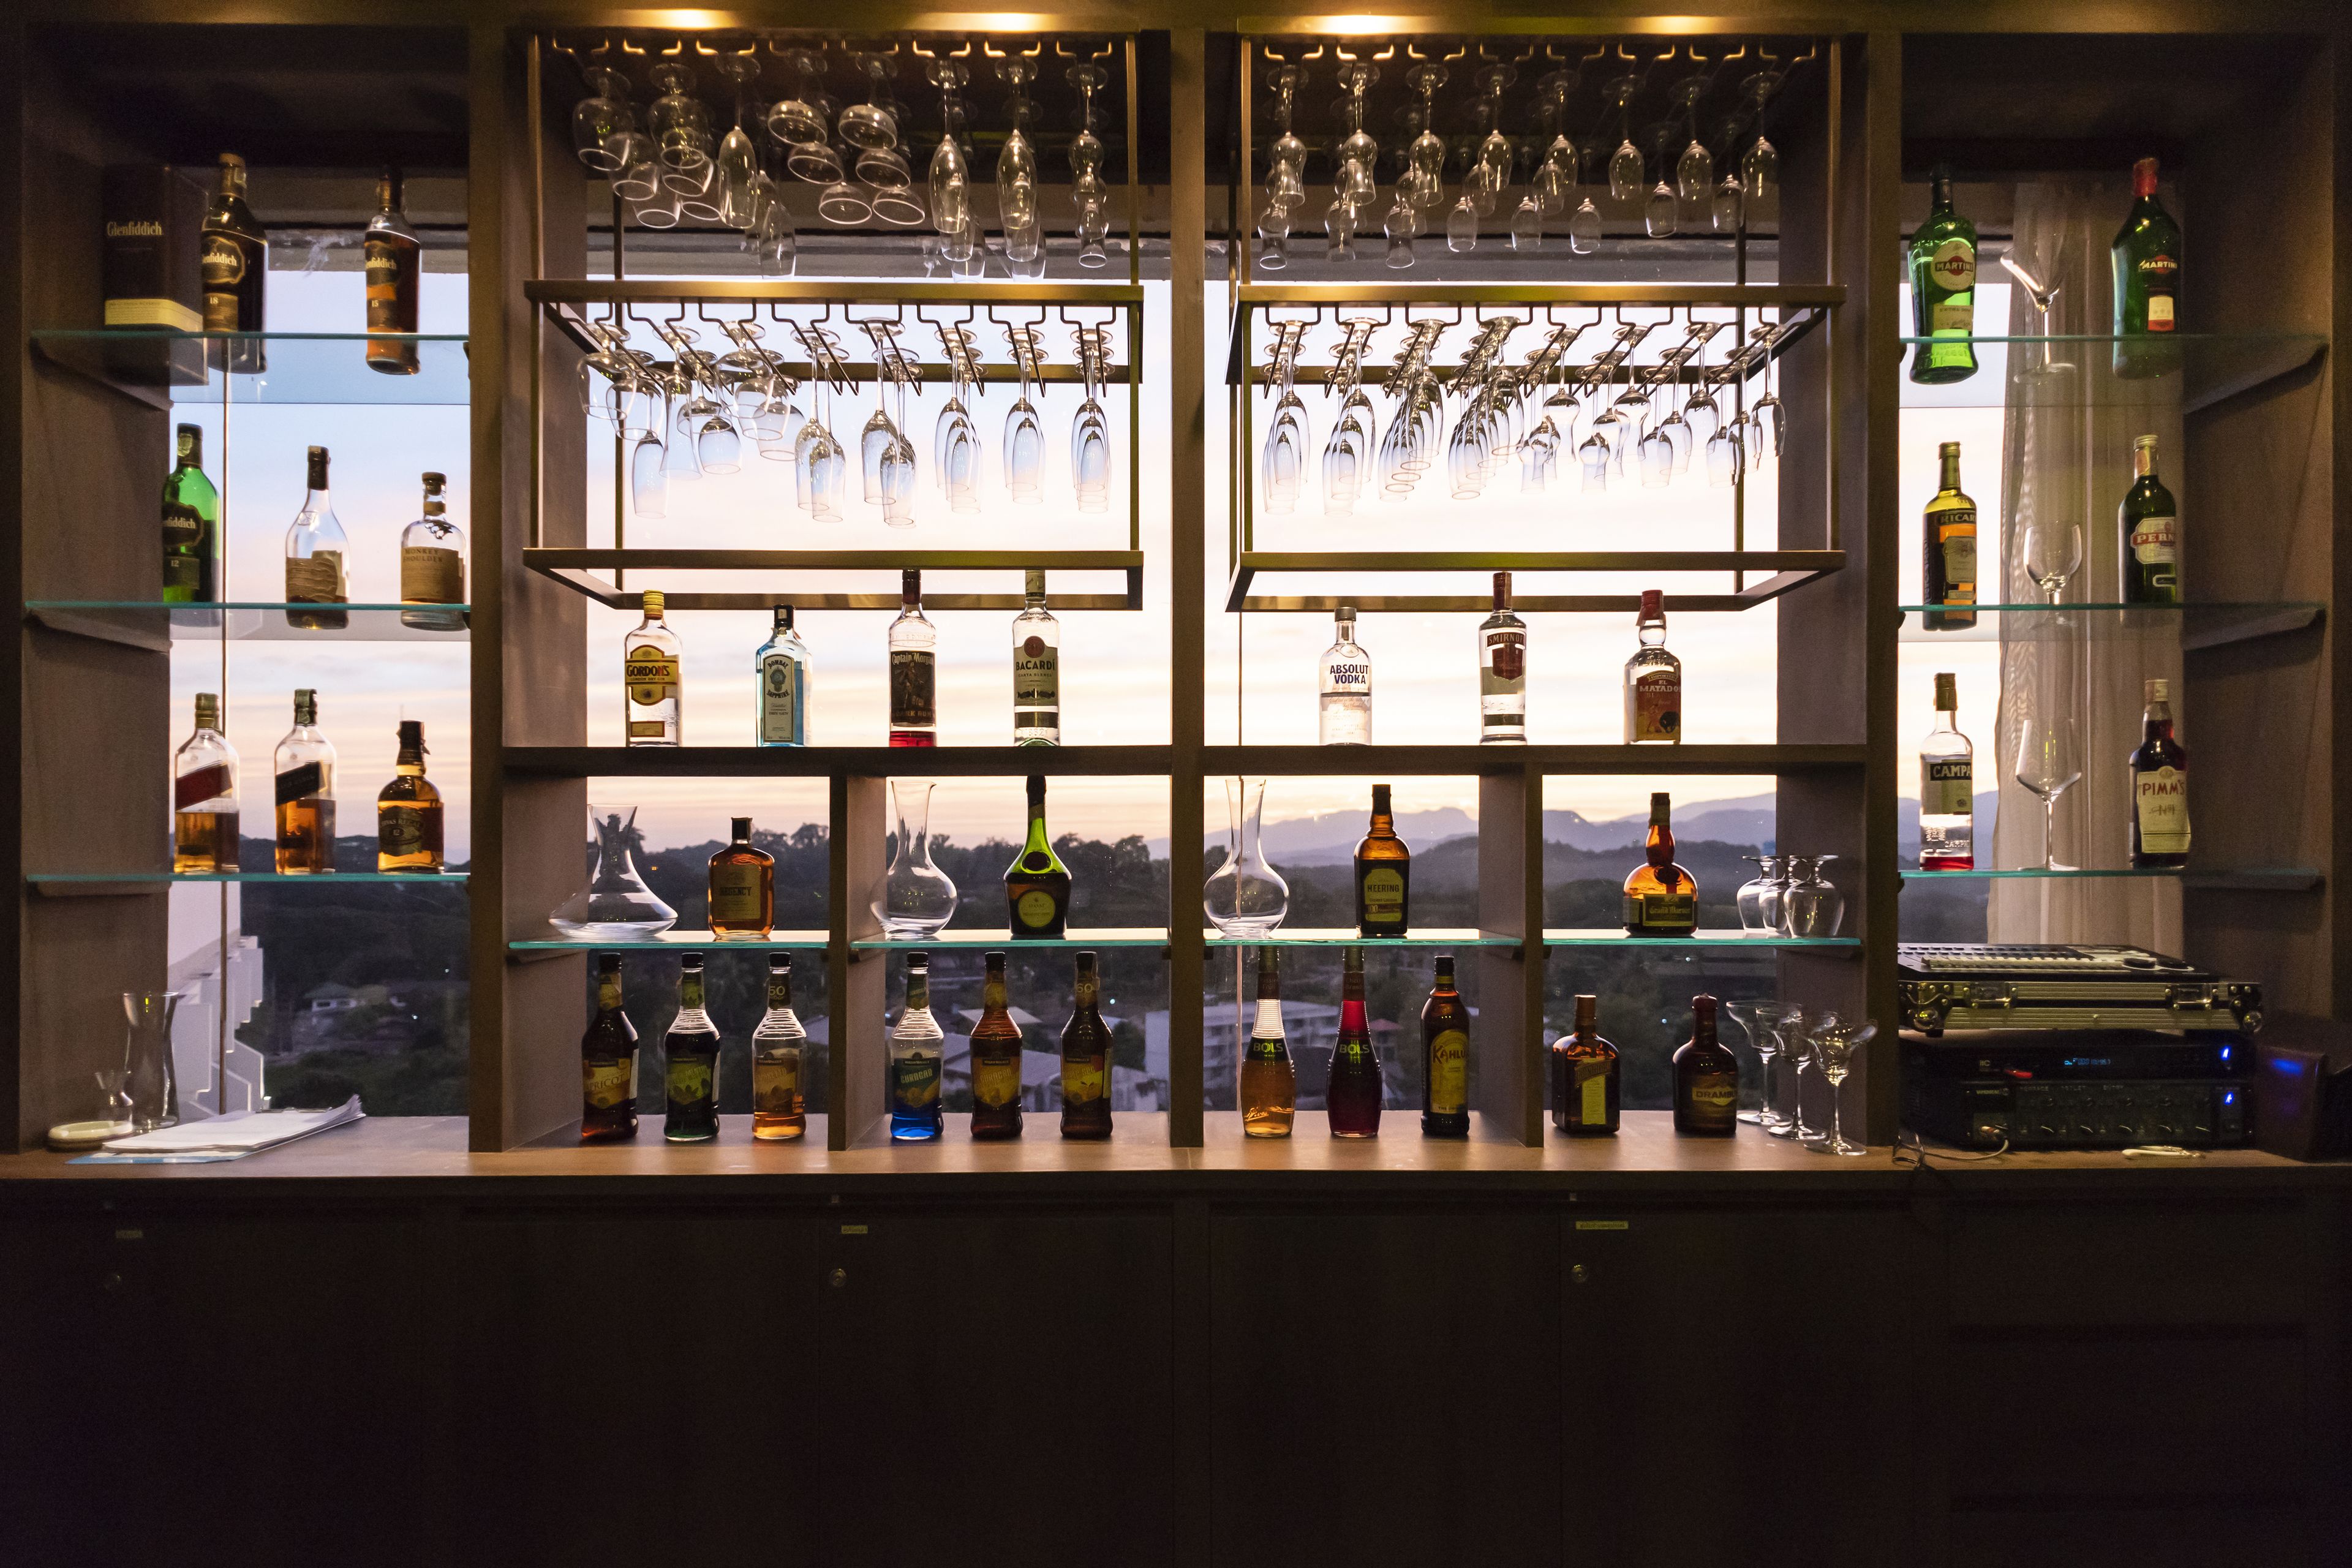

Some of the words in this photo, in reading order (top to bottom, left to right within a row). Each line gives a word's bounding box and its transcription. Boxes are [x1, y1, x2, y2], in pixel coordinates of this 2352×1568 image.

[107, 221, 163, 237] Glenfiddich
[1936, 262, 1973, 271] MARTINI
[2139, 258, 2177, 270] MARTINI
[767, 660, 789, 669] BOMBAY
[892, 653, 912, 666] Captain
[1016, 659, 1055, 671] BACARDÍ
[627, 665, 670, 677] GORDON'S
[1330, 665, 1368, 675] ABSOLUT
[1334, 674, 1366, 685] VODKA
[766, 689, 790, 699] SAPPHIRE
[2143, 780, 2185, 796] PIMM'S
[720, 886, 752, 896] REGENCY
[1254, 1042, 1284, 1053] BOLS
[1339, 1044, 1370, 1054] BOLS
